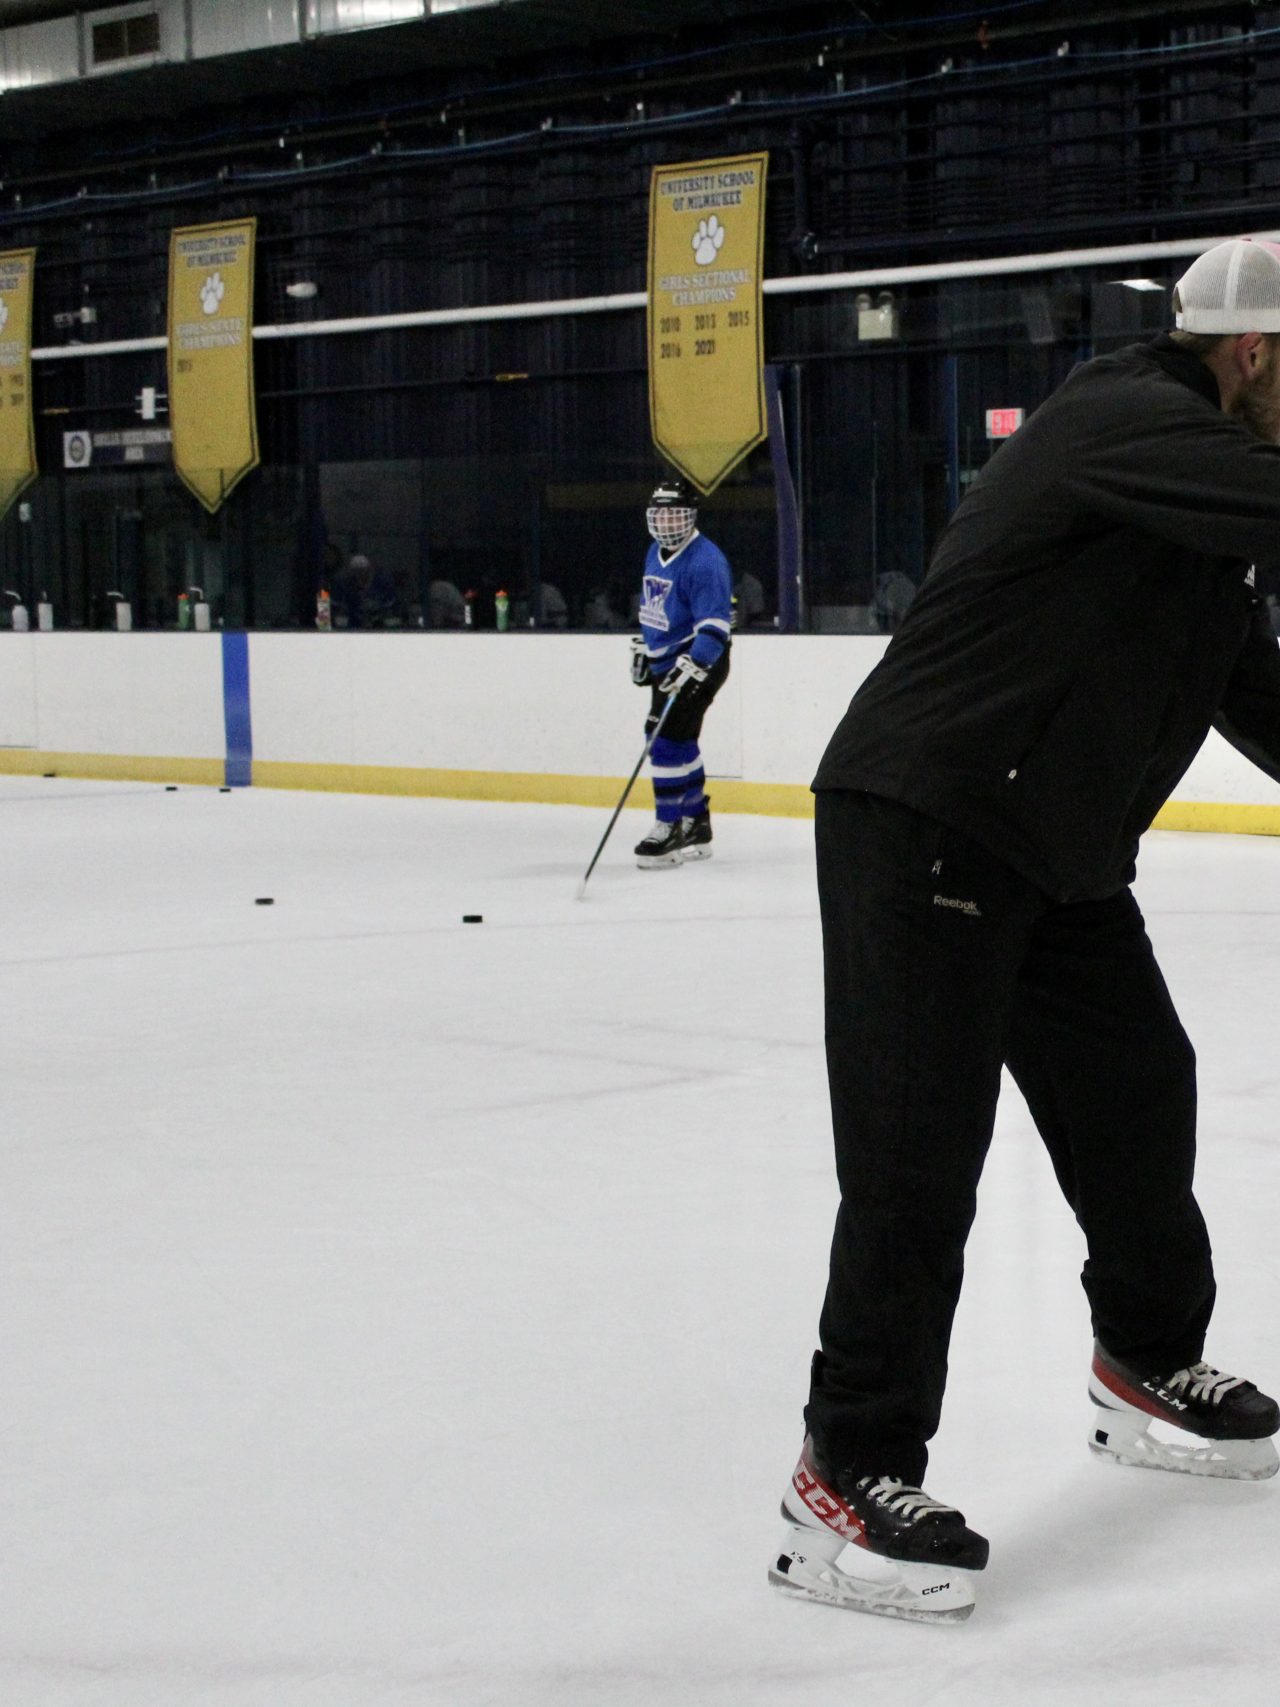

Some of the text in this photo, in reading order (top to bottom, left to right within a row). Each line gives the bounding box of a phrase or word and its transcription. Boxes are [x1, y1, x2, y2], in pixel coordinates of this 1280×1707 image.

[660, 171, 754, 194] UNIVERSITY SCHOOL
[673, 191, 741, 211] OF MILWAUKEE
[661, 269, 749, 290] GIRLS SECTIONAL
[673, 287, 735, 306] CHAMPIONS
[933, 895, 977, 911] Reebok
[921, 1582, 950, 1596] CCM
